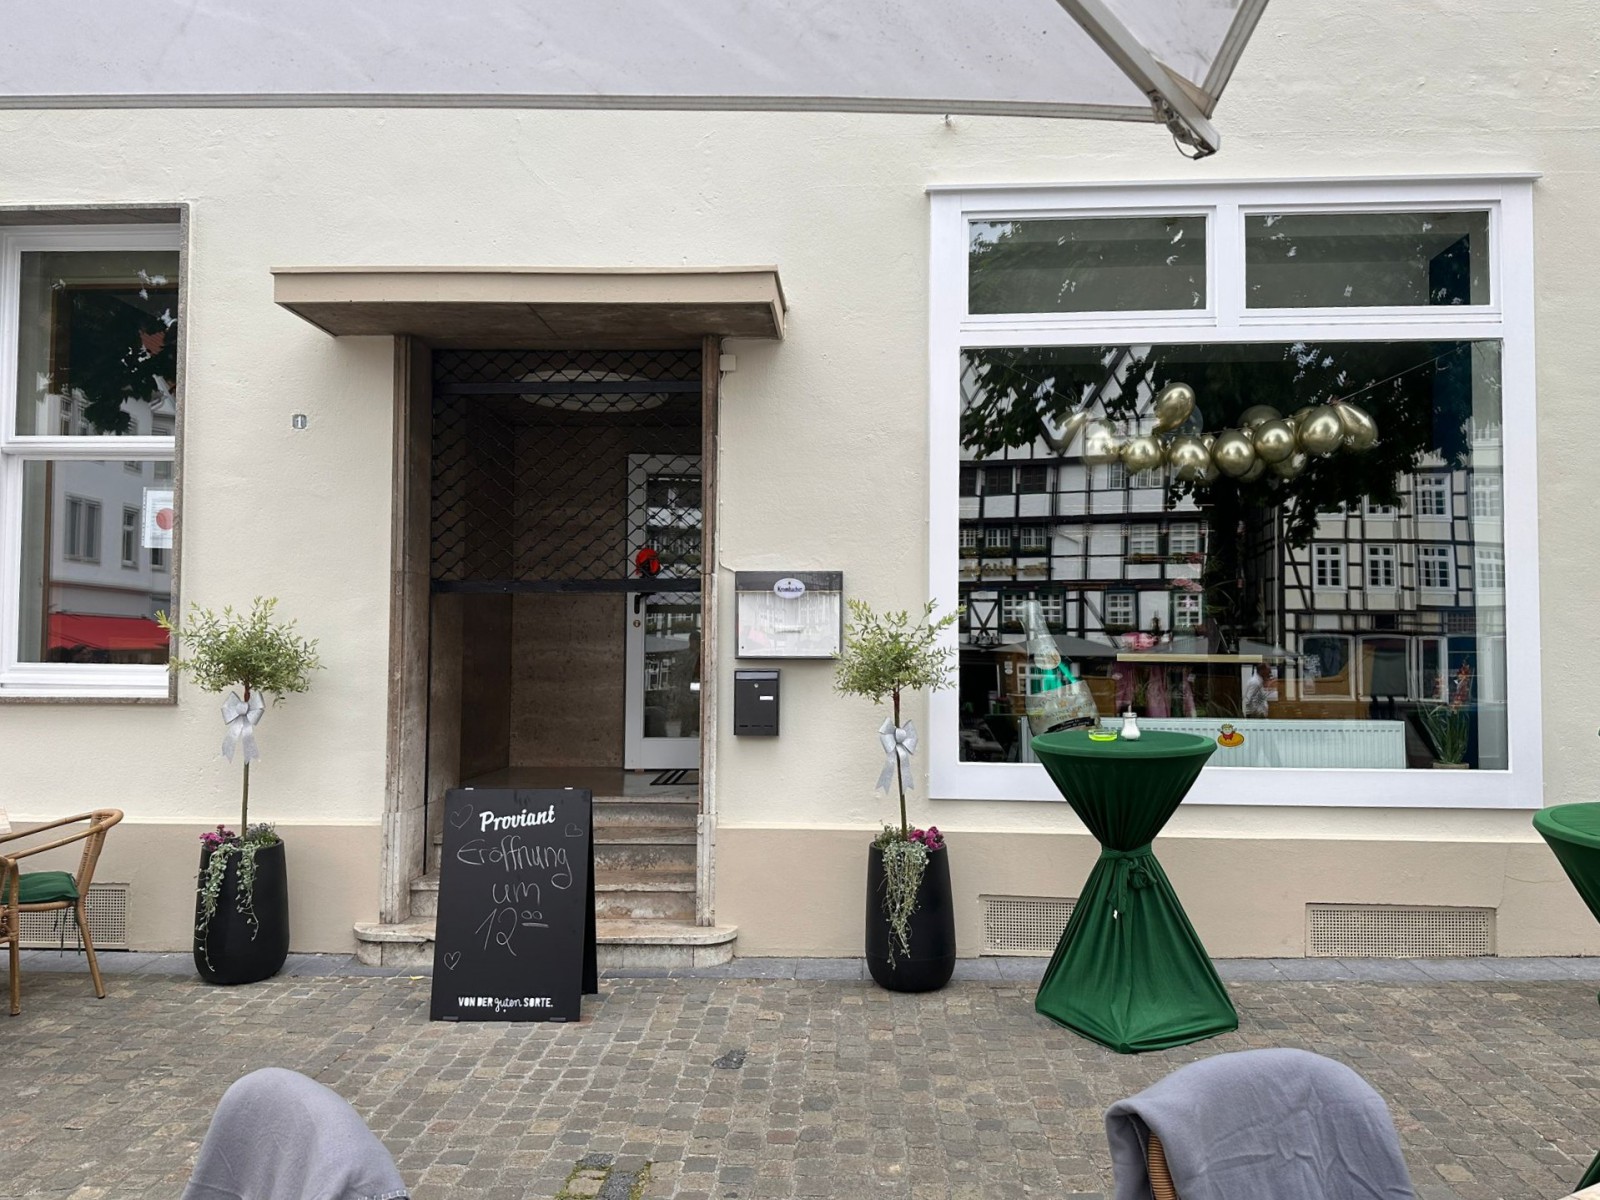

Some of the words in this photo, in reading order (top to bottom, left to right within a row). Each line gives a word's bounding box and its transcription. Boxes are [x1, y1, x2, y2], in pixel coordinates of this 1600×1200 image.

[479, 804, 556, 833] Proviant
[457, 835, 573, 889] Eröffnung
[492, 881, 540, 905] um
[458, 996, 476, 1007] VON
[477, 996, 493, 1007] DER
[494, 997, 522, 1013] guten
[523, 997, 554, 1008] SORTE.
